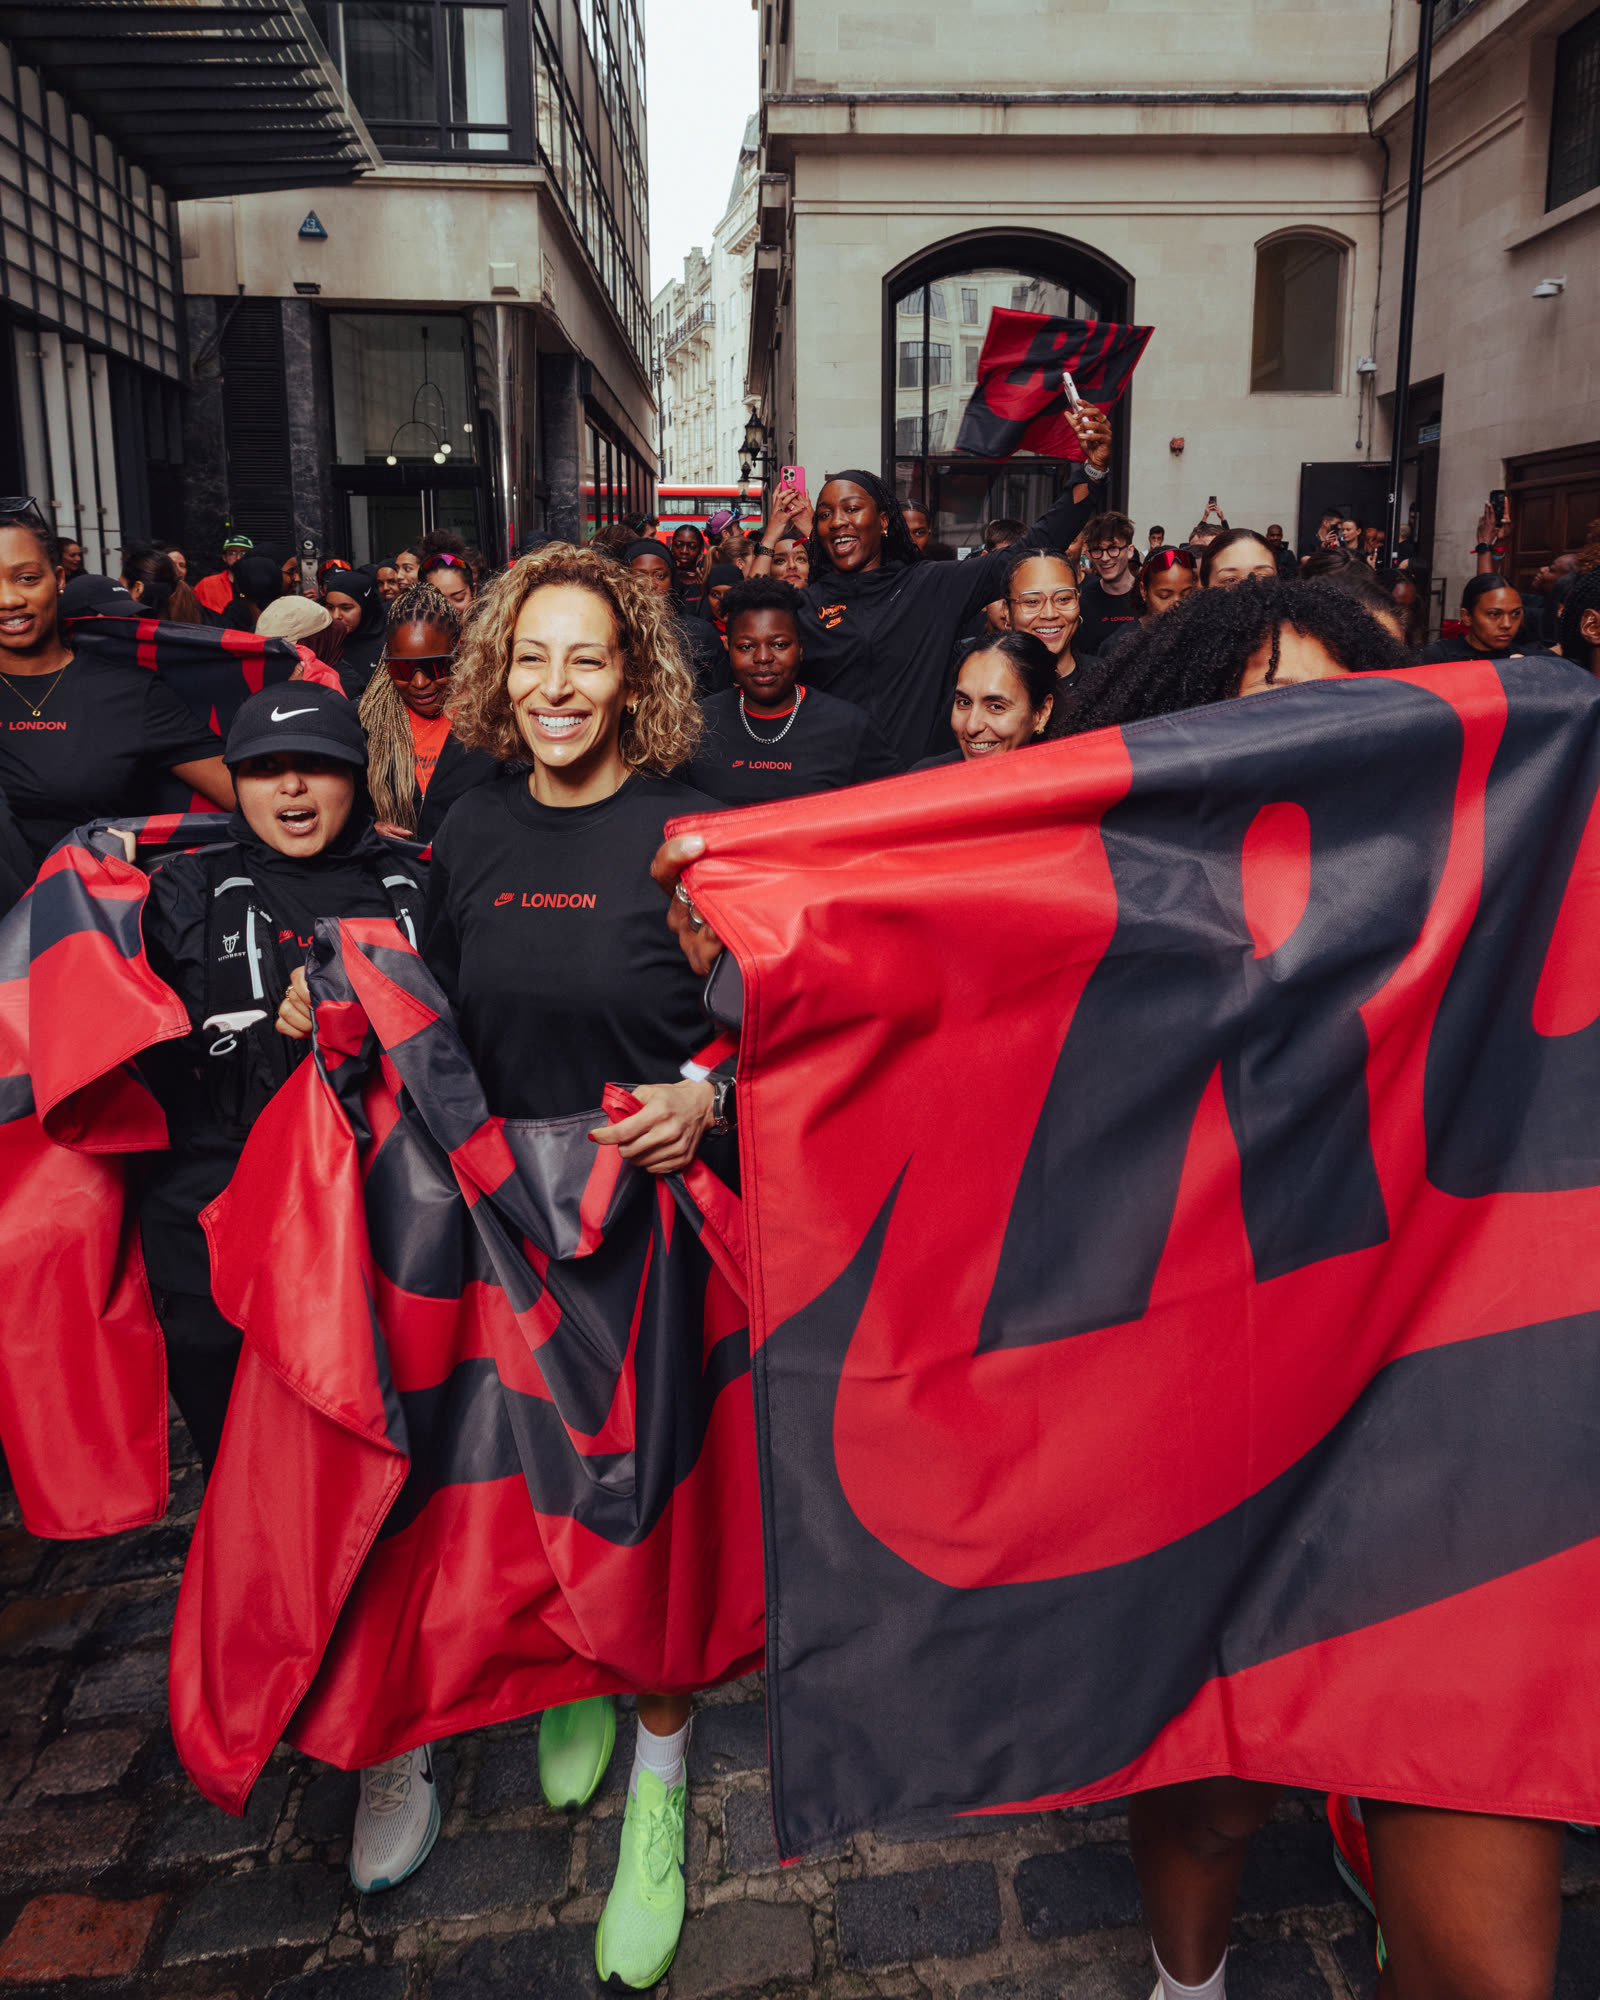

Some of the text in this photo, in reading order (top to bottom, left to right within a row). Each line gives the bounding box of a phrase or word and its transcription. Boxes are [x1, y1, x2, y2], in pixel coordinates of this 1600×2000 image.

[1388, 493, 1394, 503] 3
[9, 721, 67, 730] LONDON
[749, 760, 792, 770] LONDON
[521, 892, 597, 909] LONDON
